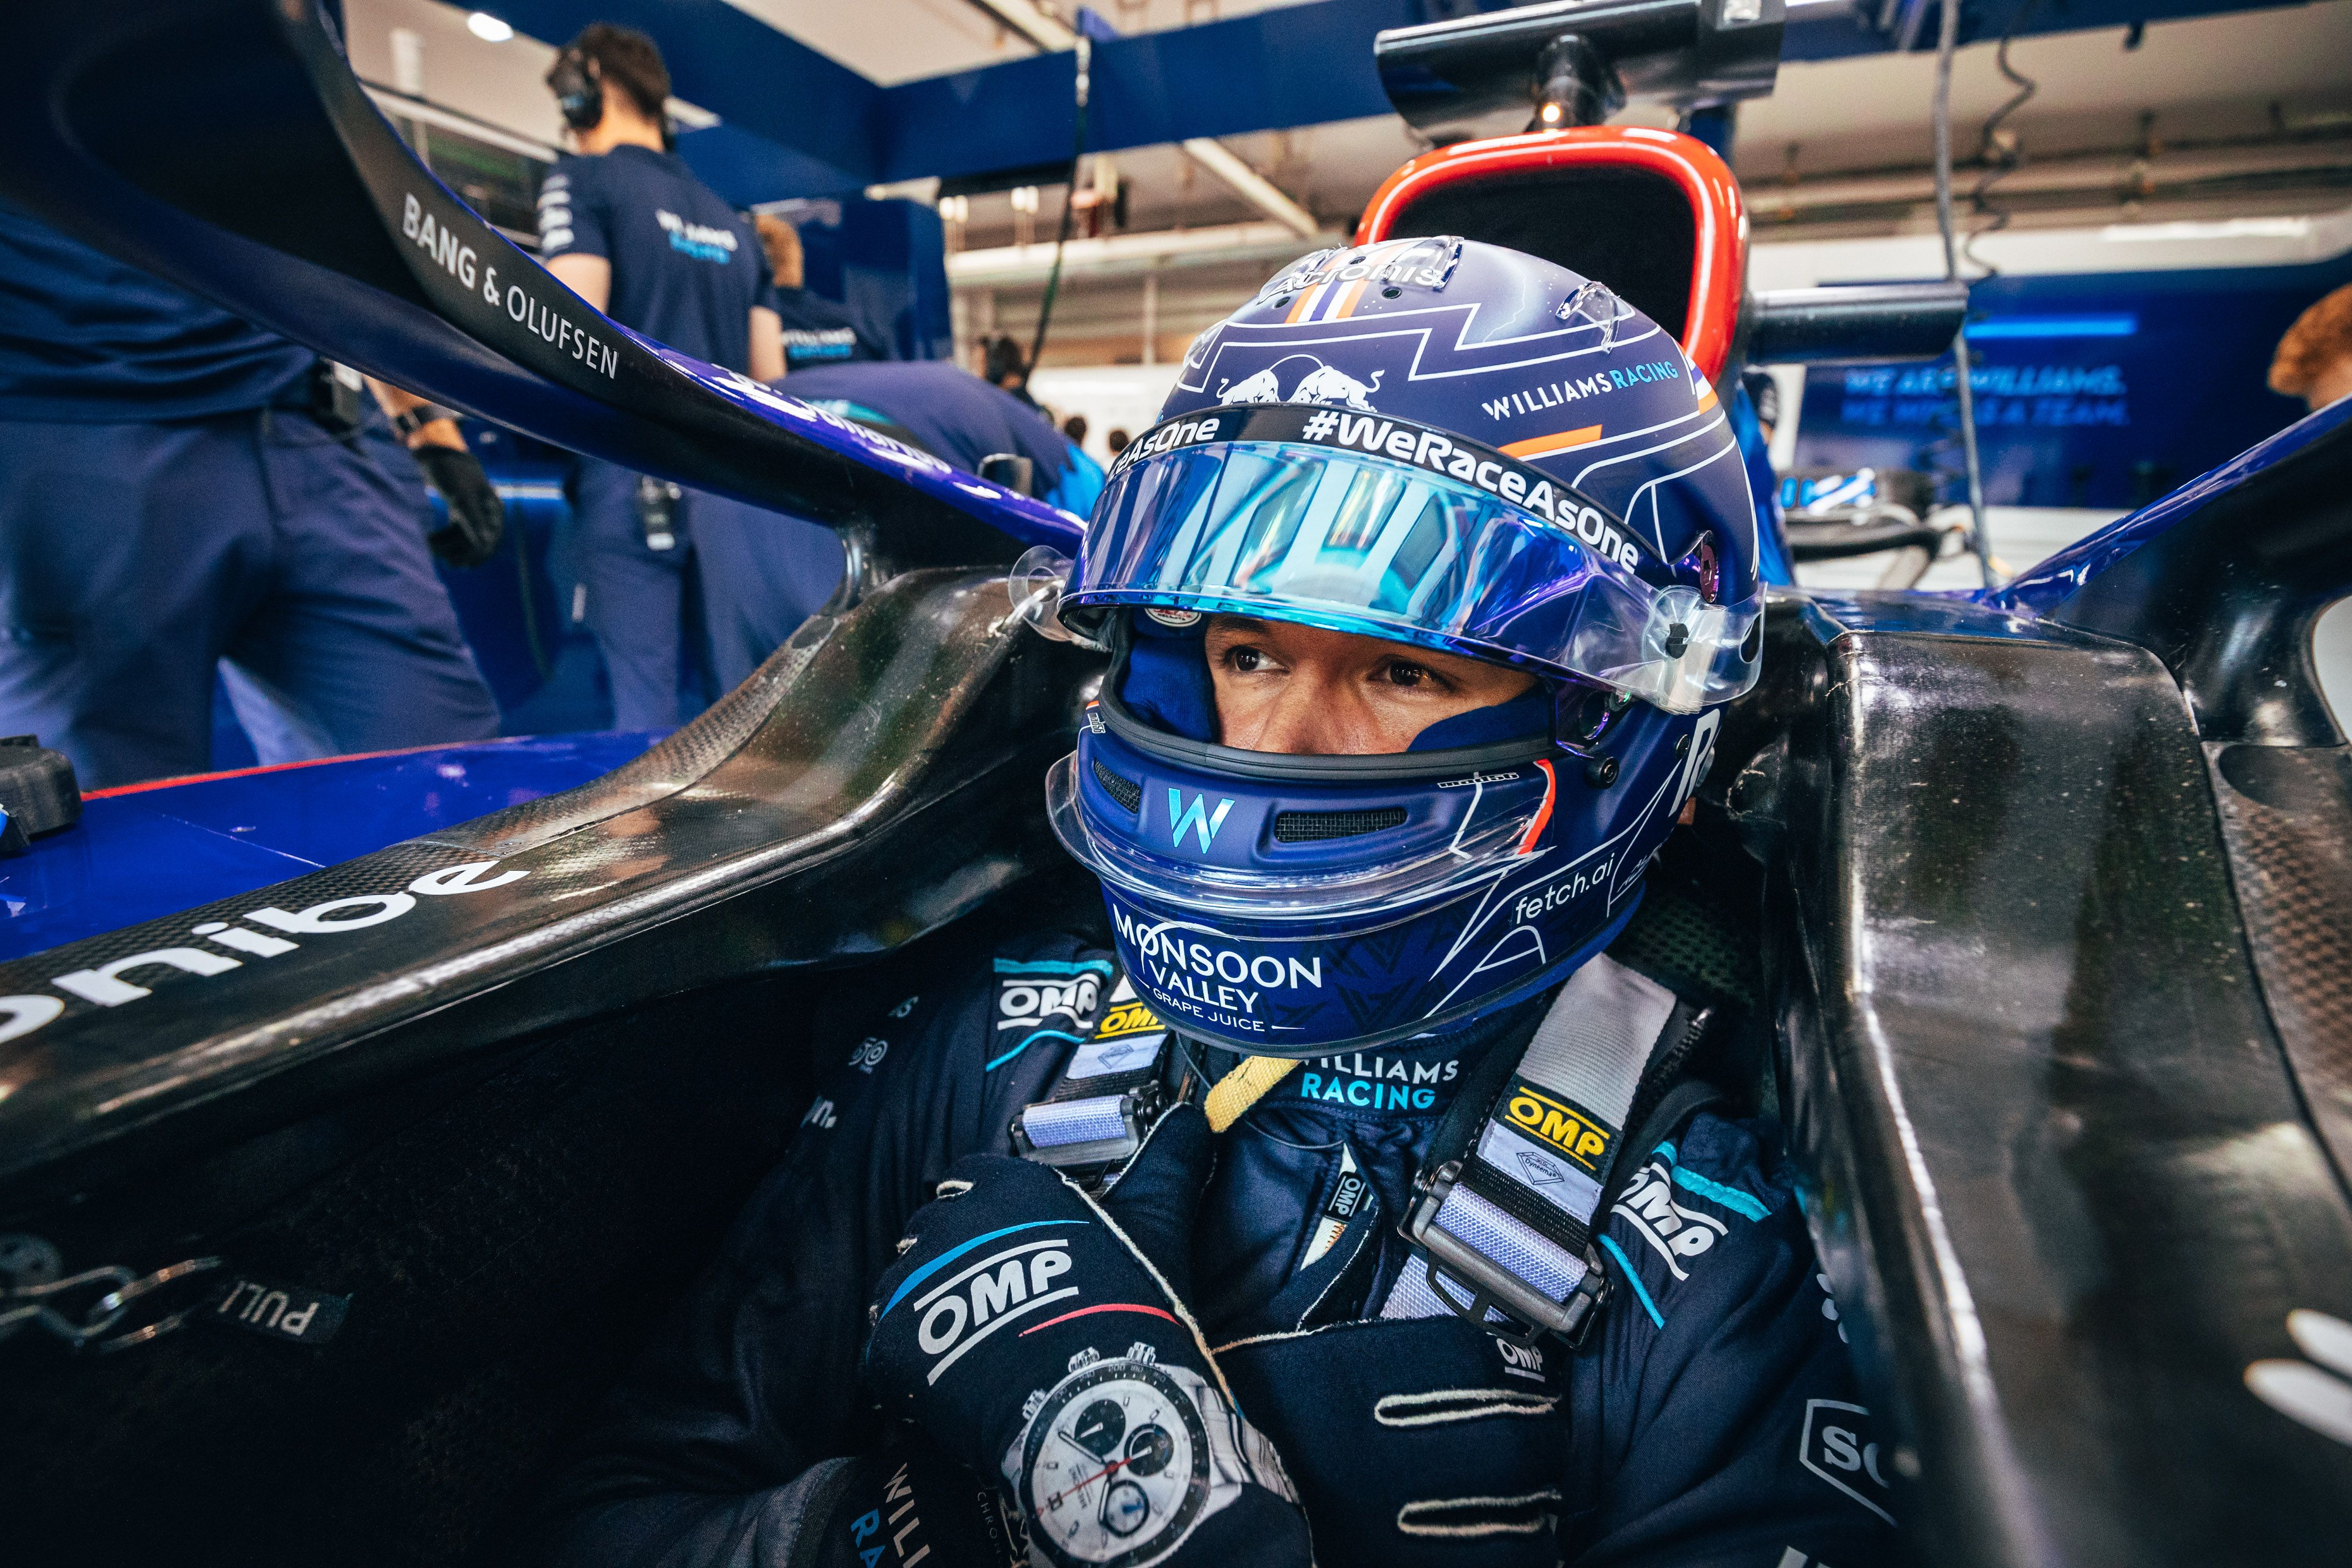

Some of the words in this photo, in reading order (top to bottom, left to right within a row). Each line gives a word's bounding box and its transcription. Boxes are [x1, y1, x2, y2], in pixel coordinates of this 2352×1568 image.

[403, 192, 477, 290] BANG
[483, 267, 500, 306] &
[507, 285, 619, 379] OLUFSEN
[1482, 373, 1612, 421] WILLIAMS
[1609, 361, 1679, 389] RACING
[1302, 410, 1639, 574] #WeRaceAsOne
[1437, 773, 1519, 788] mad56
[1168, 788, 1235, 854] W
[1516, 852, 1615, 924] fetch.ai
[1113, 903, 1322, 989] MONSOON
[999, 981, 1097, 1017] OMP
[1149, 960, 1259, 1013] VALLEY
[1154, 988, 1204, 1018] GRAPE
[1207, 1012, 1265, 1032] JUICE
[1301, 1073, 1436, 1110] RACING
[1304, 1053, 1459, 1084] ILLIAMS
[1509, 1097, 1605, 1156] OMP
[1335, 1178, 1361, 1215] OMP
[918, 1250, 1072, 1354] OMP
[1496, 1338, 1543, 1371] OMP
